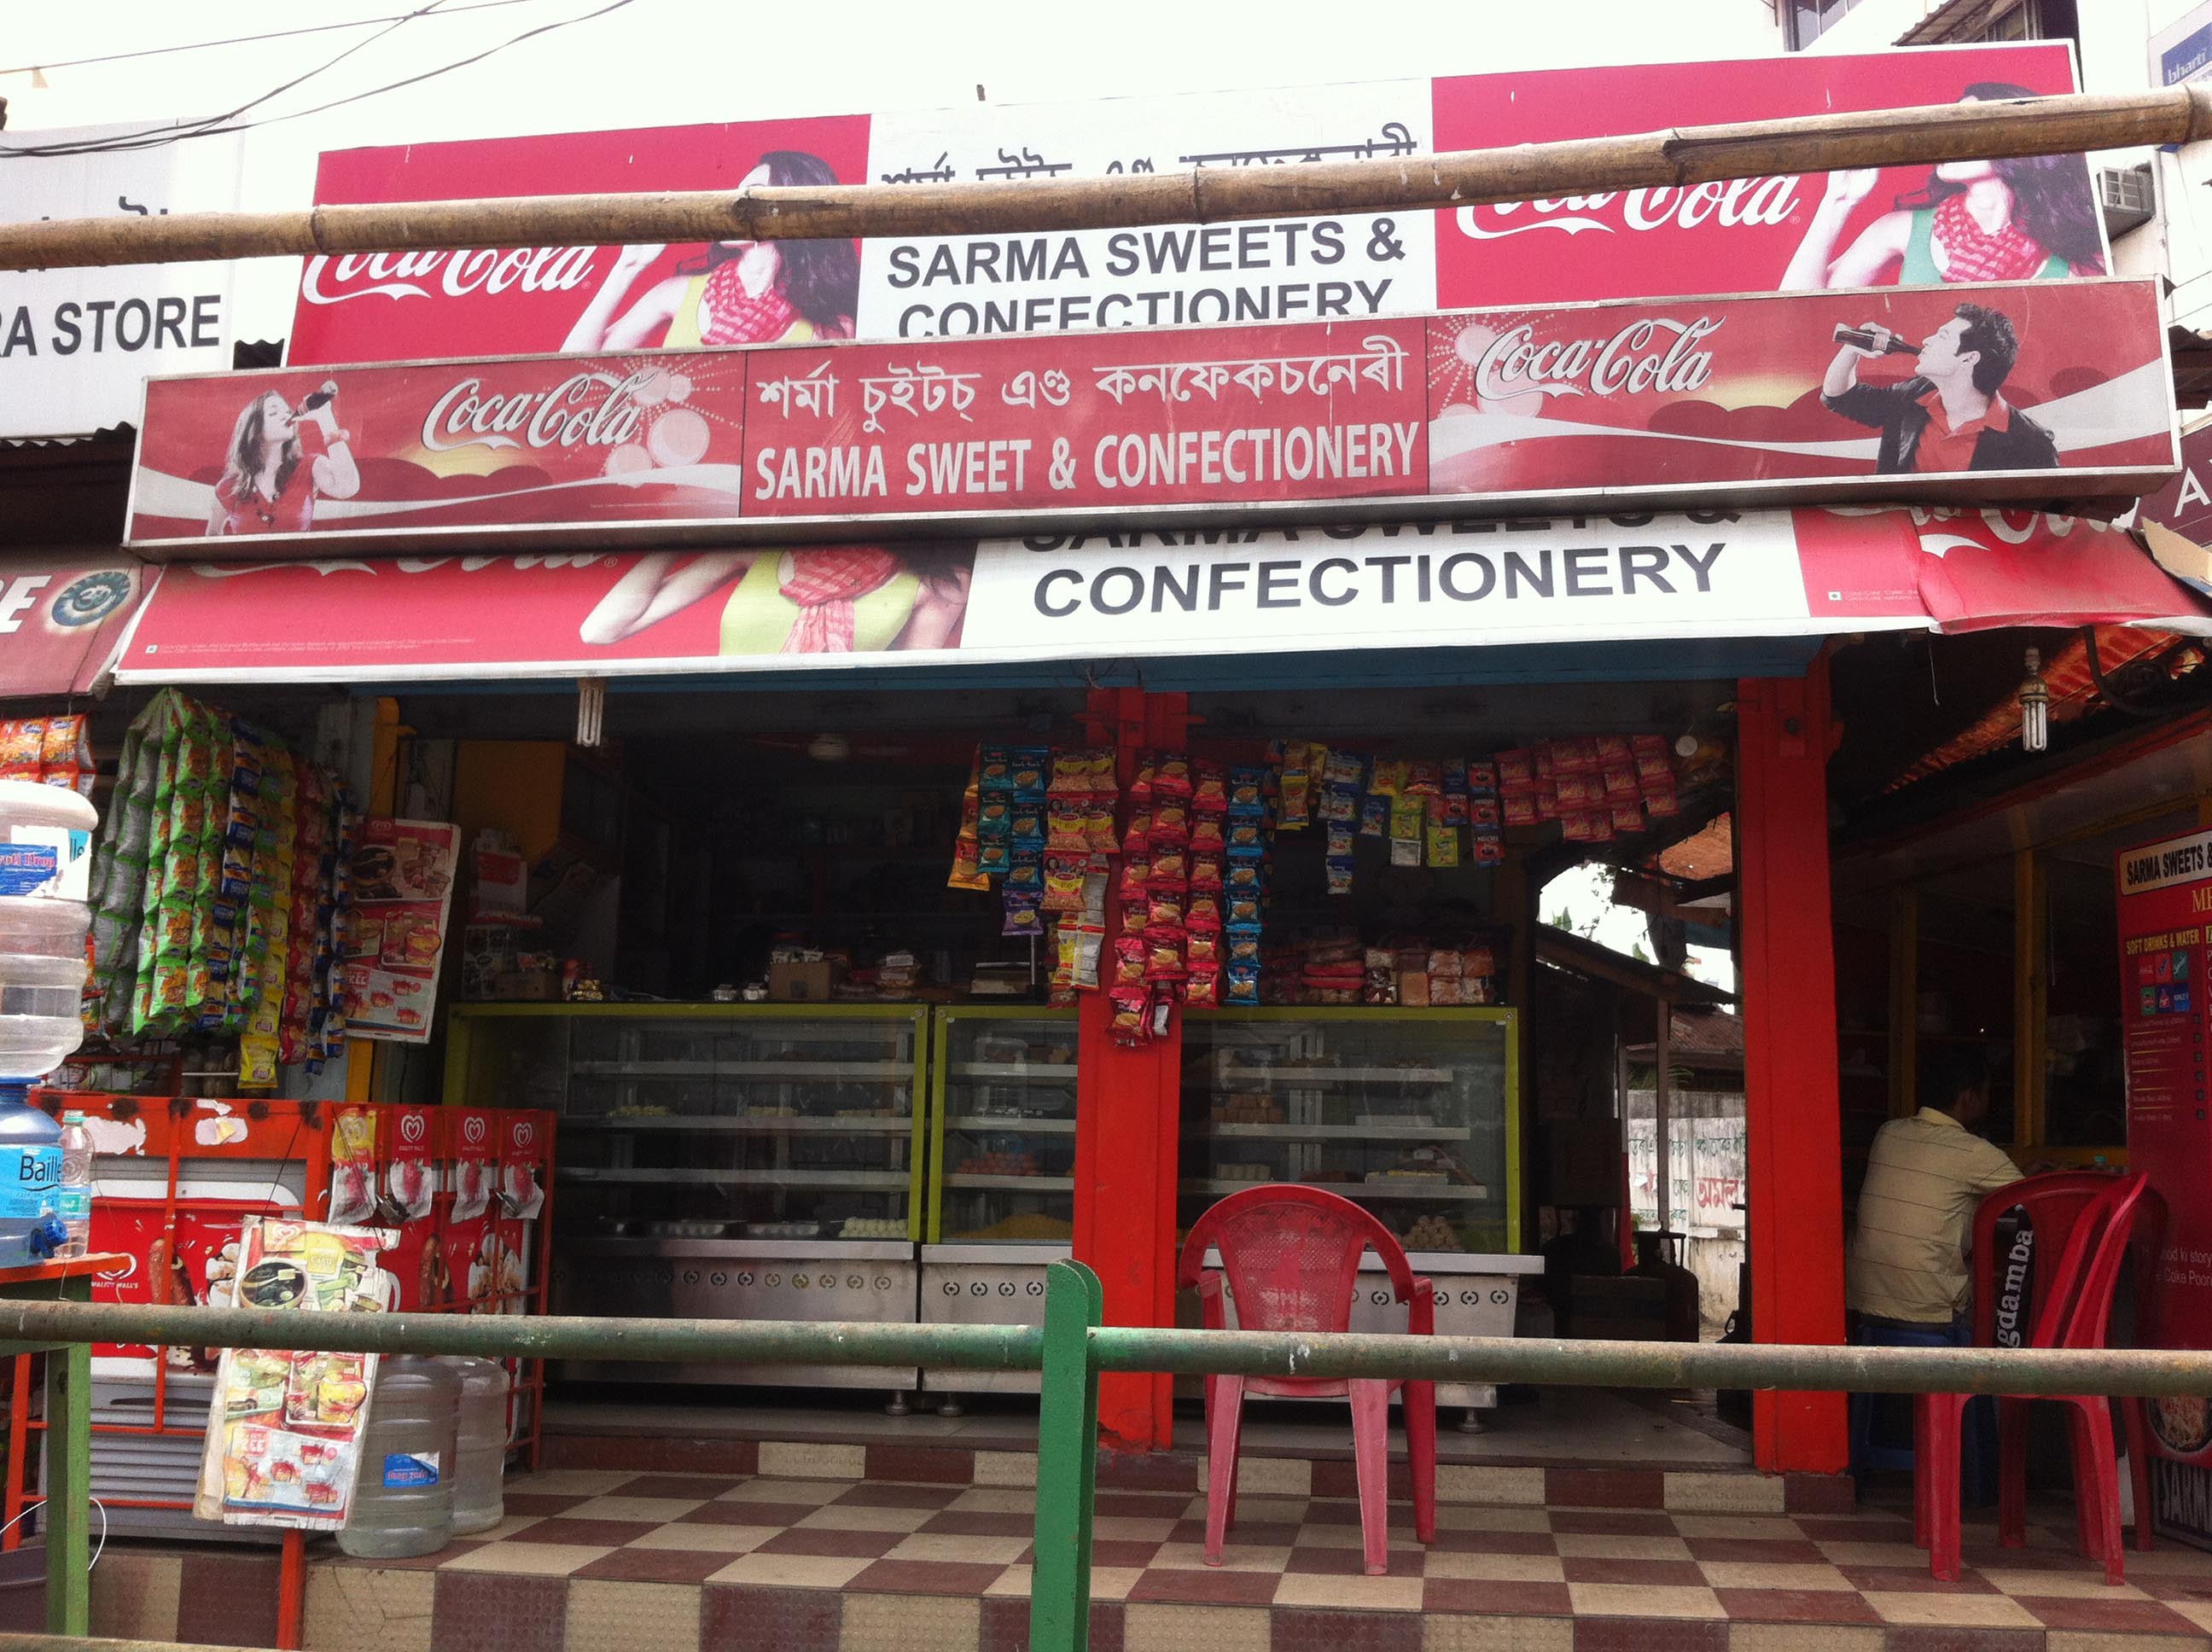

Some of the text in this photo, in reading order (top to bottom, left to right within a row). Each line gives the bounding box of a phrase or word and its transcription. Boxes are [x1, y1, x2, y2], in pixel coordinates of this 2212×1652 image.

[888, 218, 1406, 288] SARMA SWEETS &
[52, 294, 221, 356] STORE
[1474, 316, 1726, 399] Coca-Cola
[422, 372, 659, 451] Coca-Cola
[755, 422, 1420, 500] SARMA SWEET & CONFECTIONERY
[0, 574, 52, 634] E
[1033, 543, 1727, 618] CONFECTIONERY
[2126, 855, 2162, 887] SARMA
[2163, 844, 2203, 878] SWEETS
